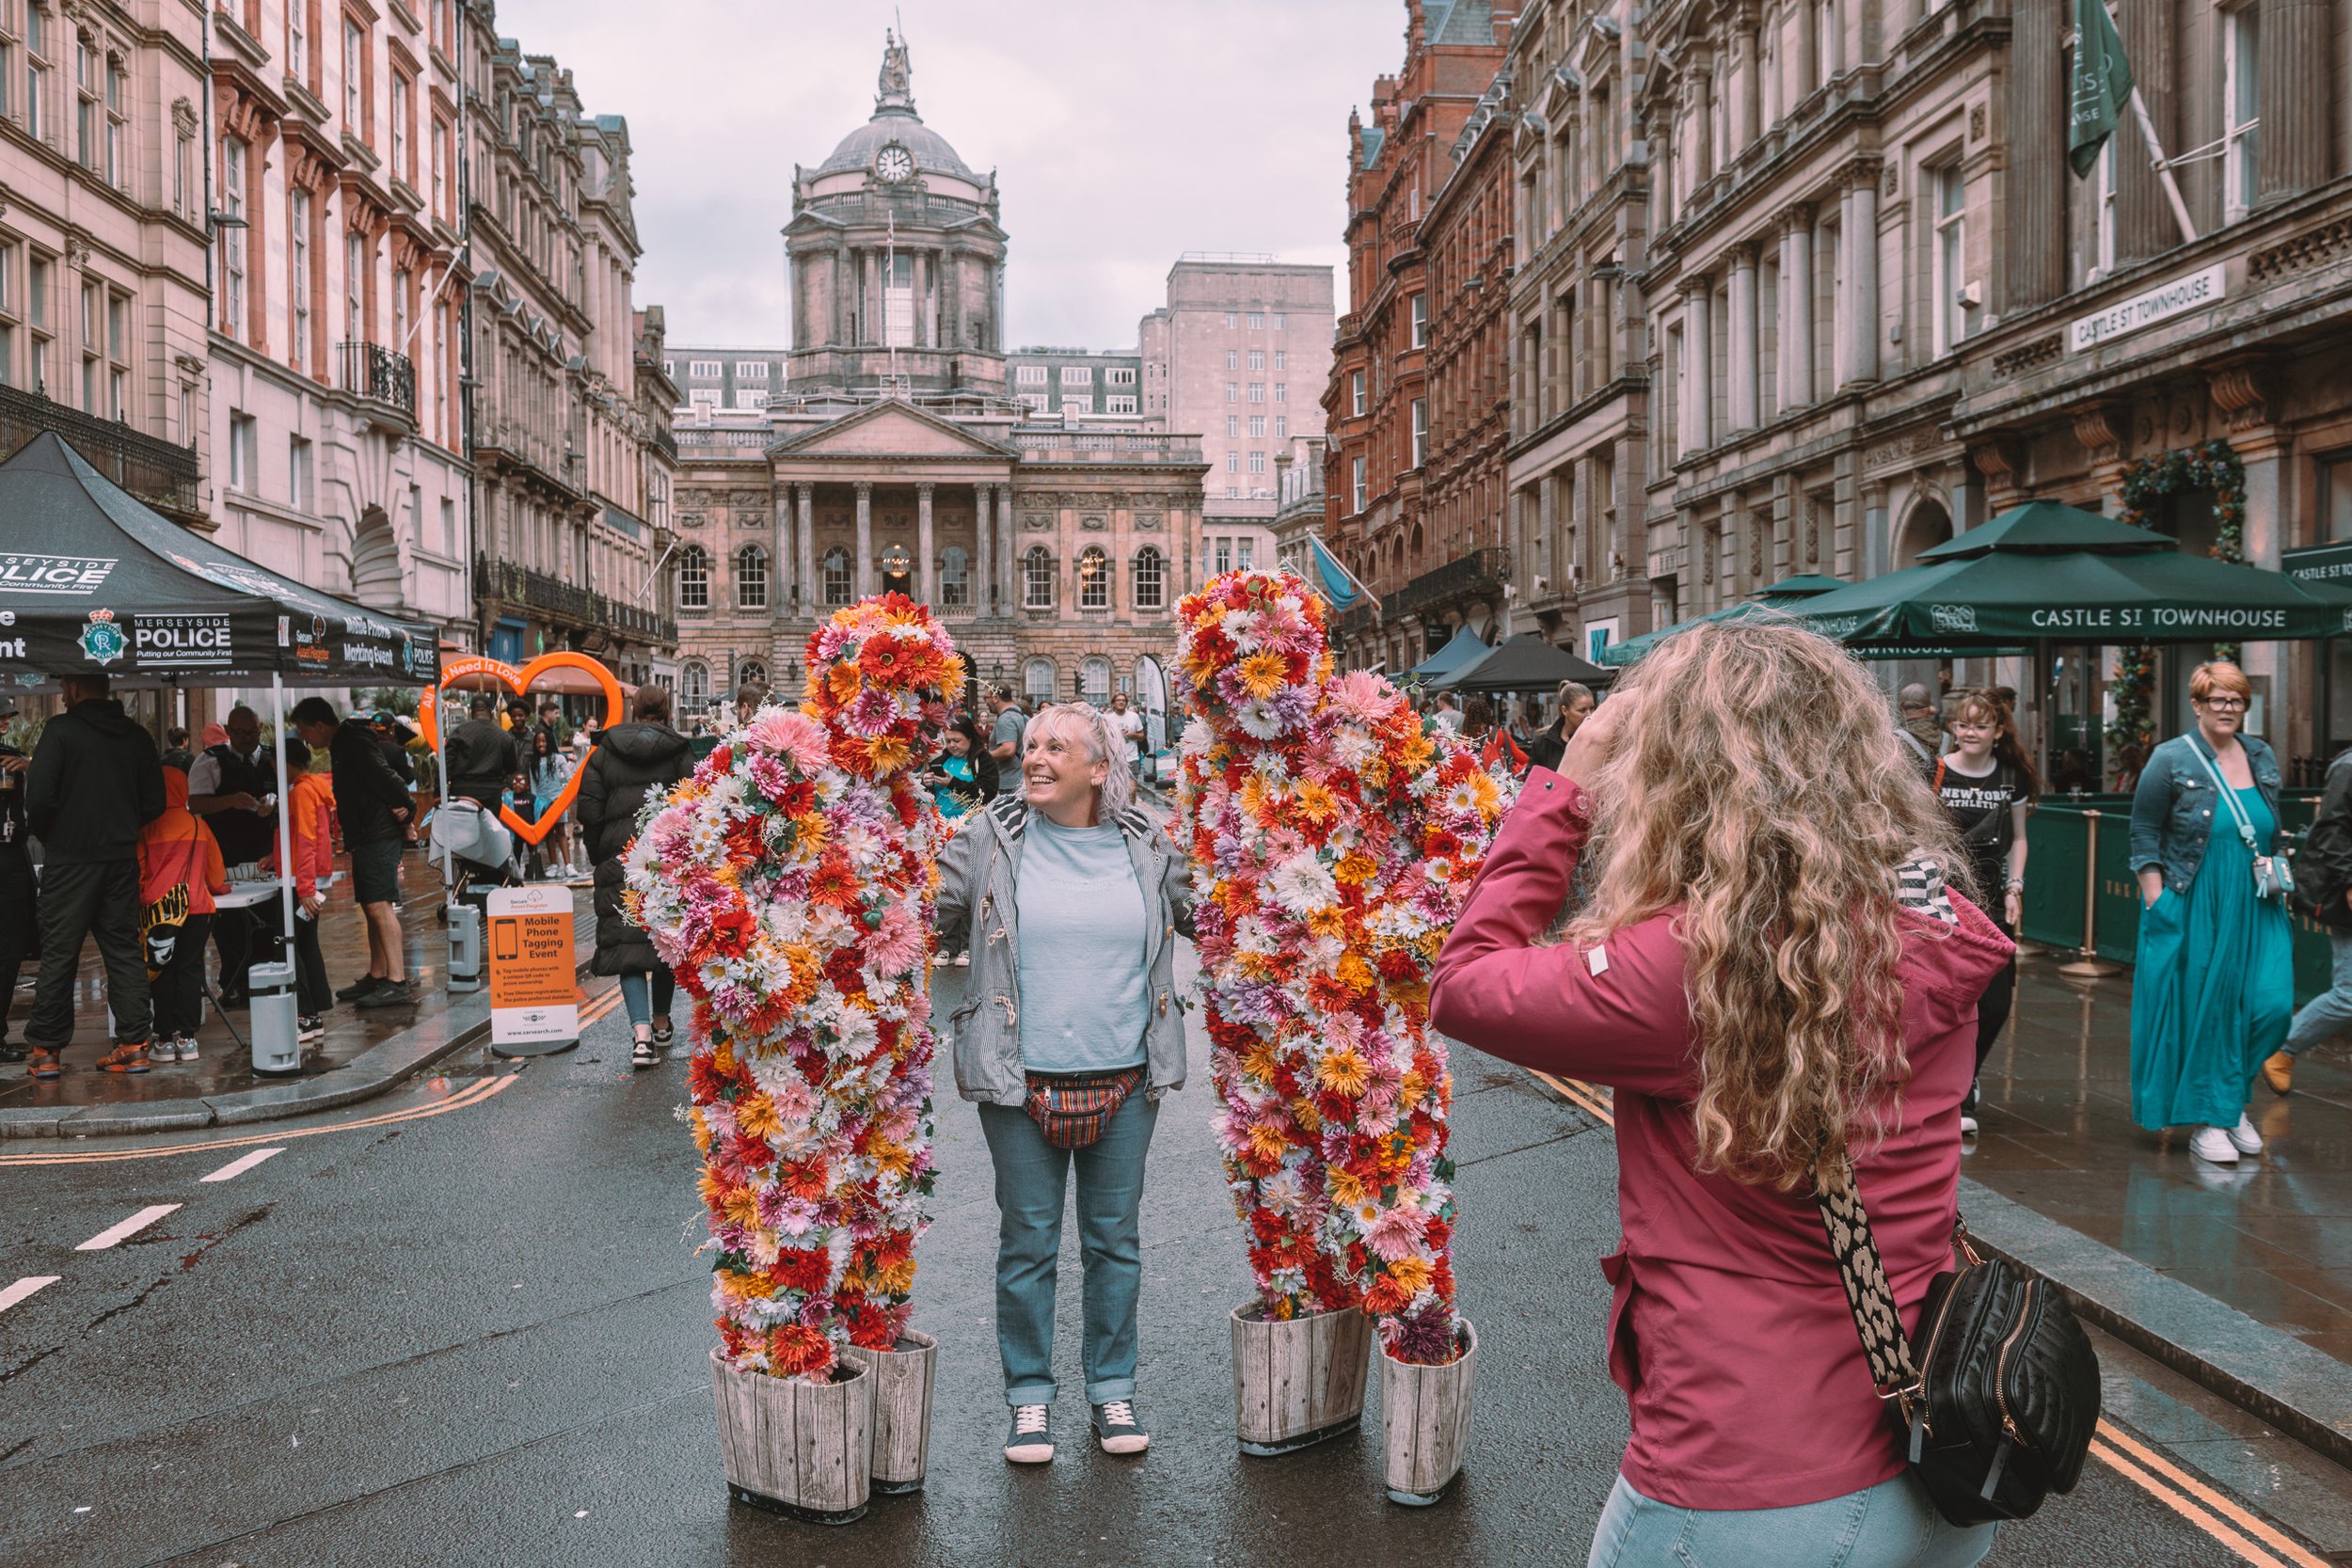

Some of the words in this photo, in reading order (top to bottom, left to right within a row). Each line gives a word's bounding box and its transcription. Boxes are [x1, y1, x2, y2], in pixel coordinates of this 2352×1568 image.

[2078, 313, 2116, 342] CASTLE
[2121, 307, 2134, 327] ST
[2137, 276, 2210, 321] TOWNHOUSE
[2292, 565, 2327, 580] CASTLE
[135, 618, 230, 627] MERSEYSIDE
[2031, 610, 2111, 626] CASTLE
[2120, 609, 2142, 626] ST
[2151, 609, 2286, 627] TOWNHOUSE
[86, 624, 120, 639] MERSEYSIDE
[135, 627, 231, 648] POLICE
[296, 629, 312, 644] Secure
[92, 649, 116, 658] POLICE
[136, 650, 161, 658] Putting
[176, 649, 215, 657] Community
[343, 641, 373, 669] Marking
[373, 645, 393, 666] Event
[414, 647, 434, 665] POLICE
[449, 661, 481, 677] Need
[485, 660, 494, 672] Is
[496, 662, 521, 686] Love
[422, 691, 436, 708] All
[1941, 787, 1973, 800] NEW
[1975, 790, 2008, 801] YORK
[525, 916, 560, 926] Mobile
[527, 928, 559, 937] Phone
[522, 939, 564, 949] Tagging
[529, 950, 558, 958] Event
